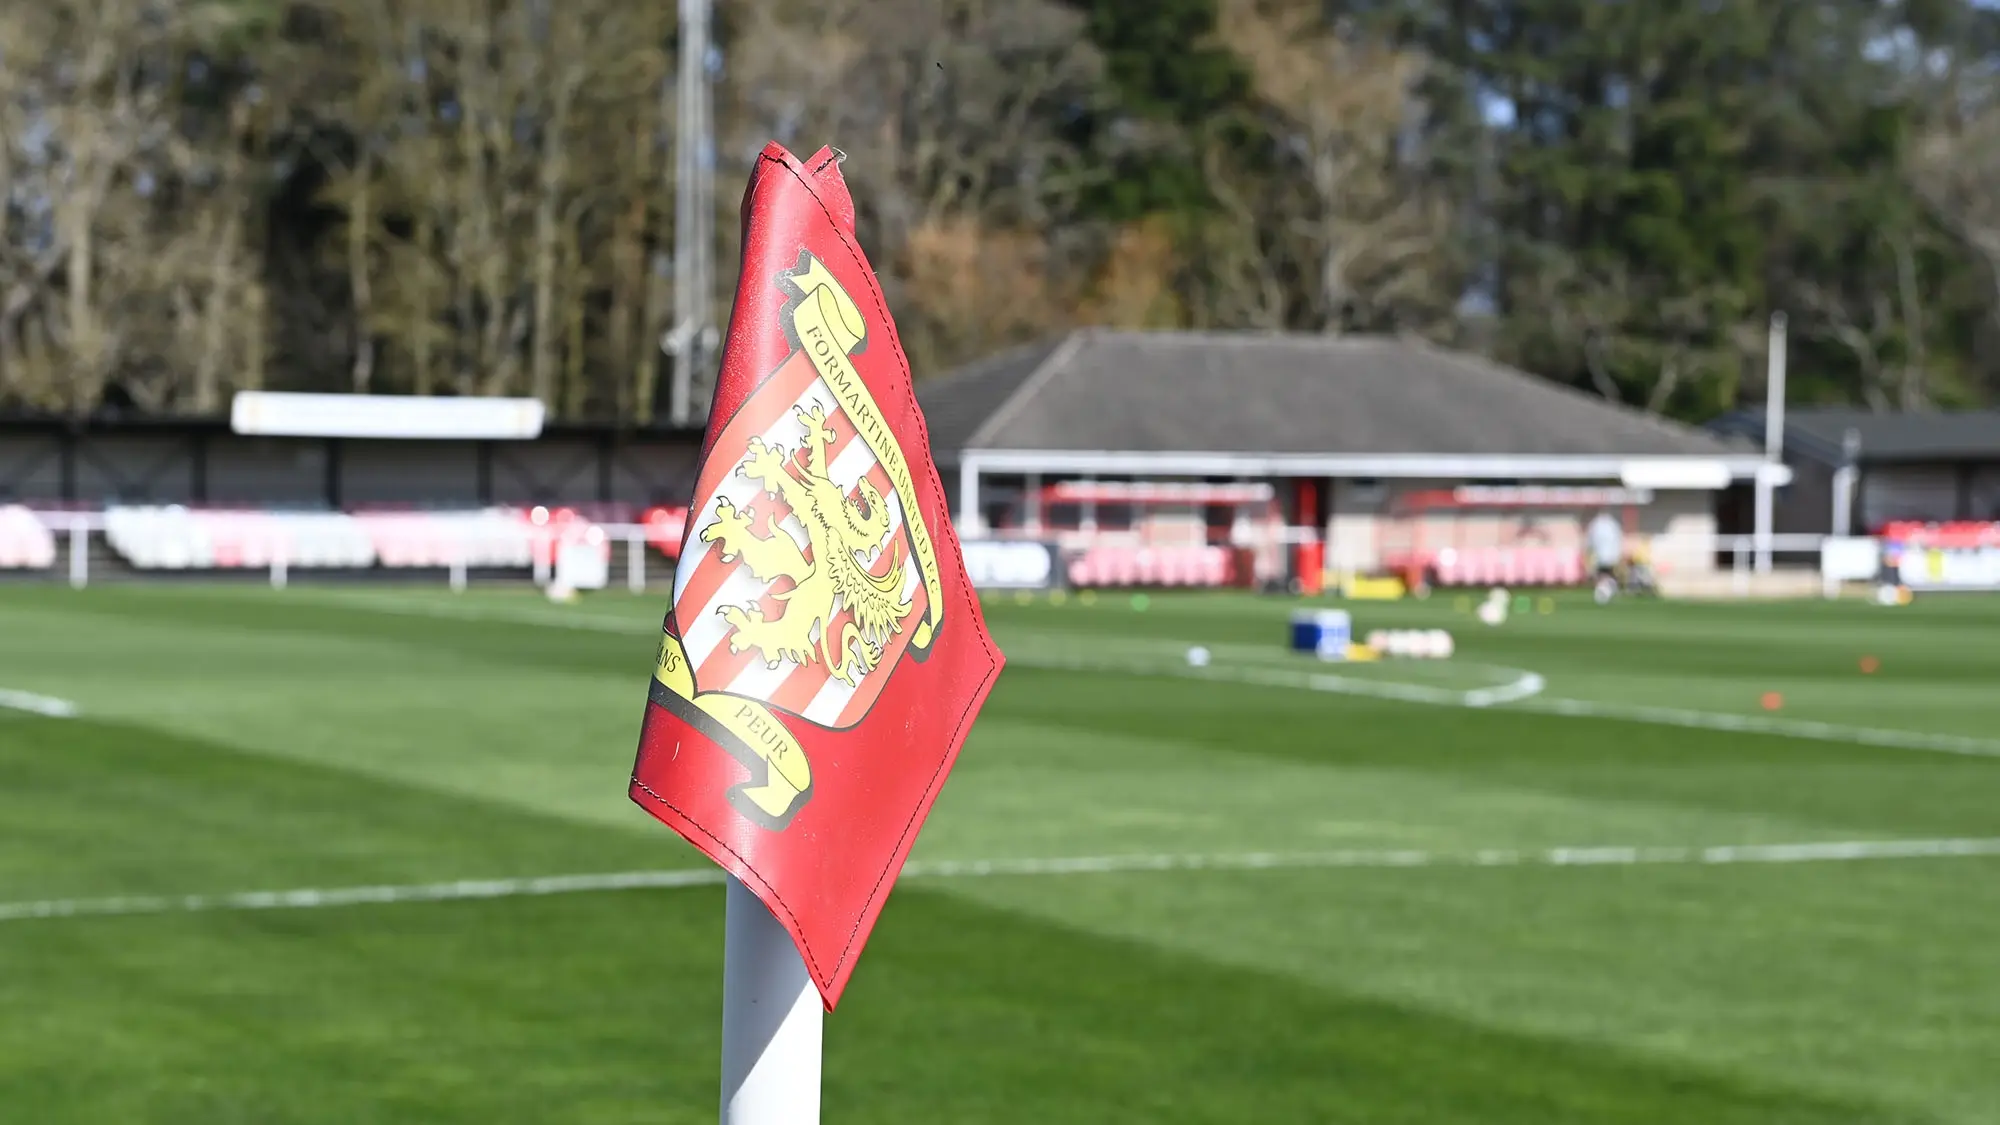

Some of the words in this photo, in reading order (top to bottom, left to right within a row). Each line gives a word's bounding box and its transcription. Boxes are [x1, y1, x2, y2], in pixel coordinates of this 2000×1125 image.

[806, 326, 899, 472] FORMARTINE
[898, 468, 928, 554] UNITED
[656, 641, 681, 673] ANS
[735, 704, 788, 760] PEUR
